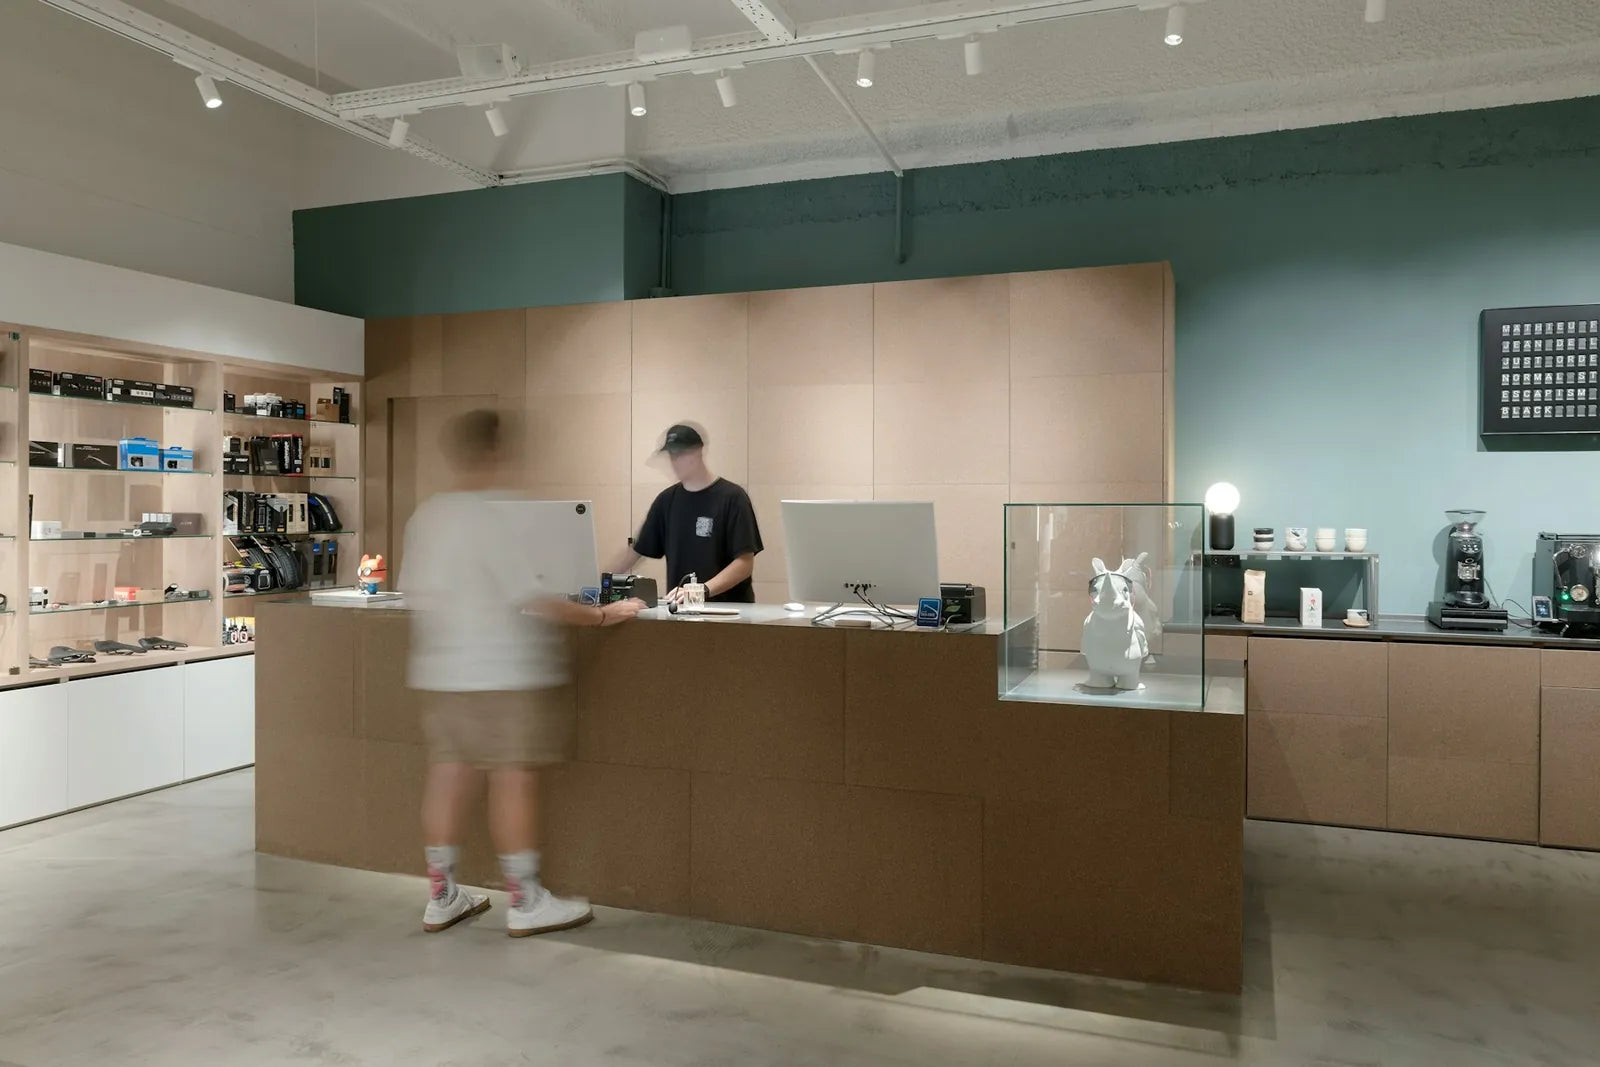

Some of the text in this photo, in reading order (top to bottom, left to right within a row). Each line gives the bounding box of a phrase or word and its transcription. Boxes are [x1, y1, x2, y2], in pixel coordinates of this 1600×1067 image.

[1502, 321, 1575, 334] MATHIEU
[1502, 339, 1542, 351] JEAN
[1556, 338, 1575, 349] DE
[1502, 356, 1542, 368] JUST
[1501, 372, 1564, 384] NORMAL
[1501, 389, 1586, 400] ESCAPISM
[1501, 405, 1552, 417] BLACK
